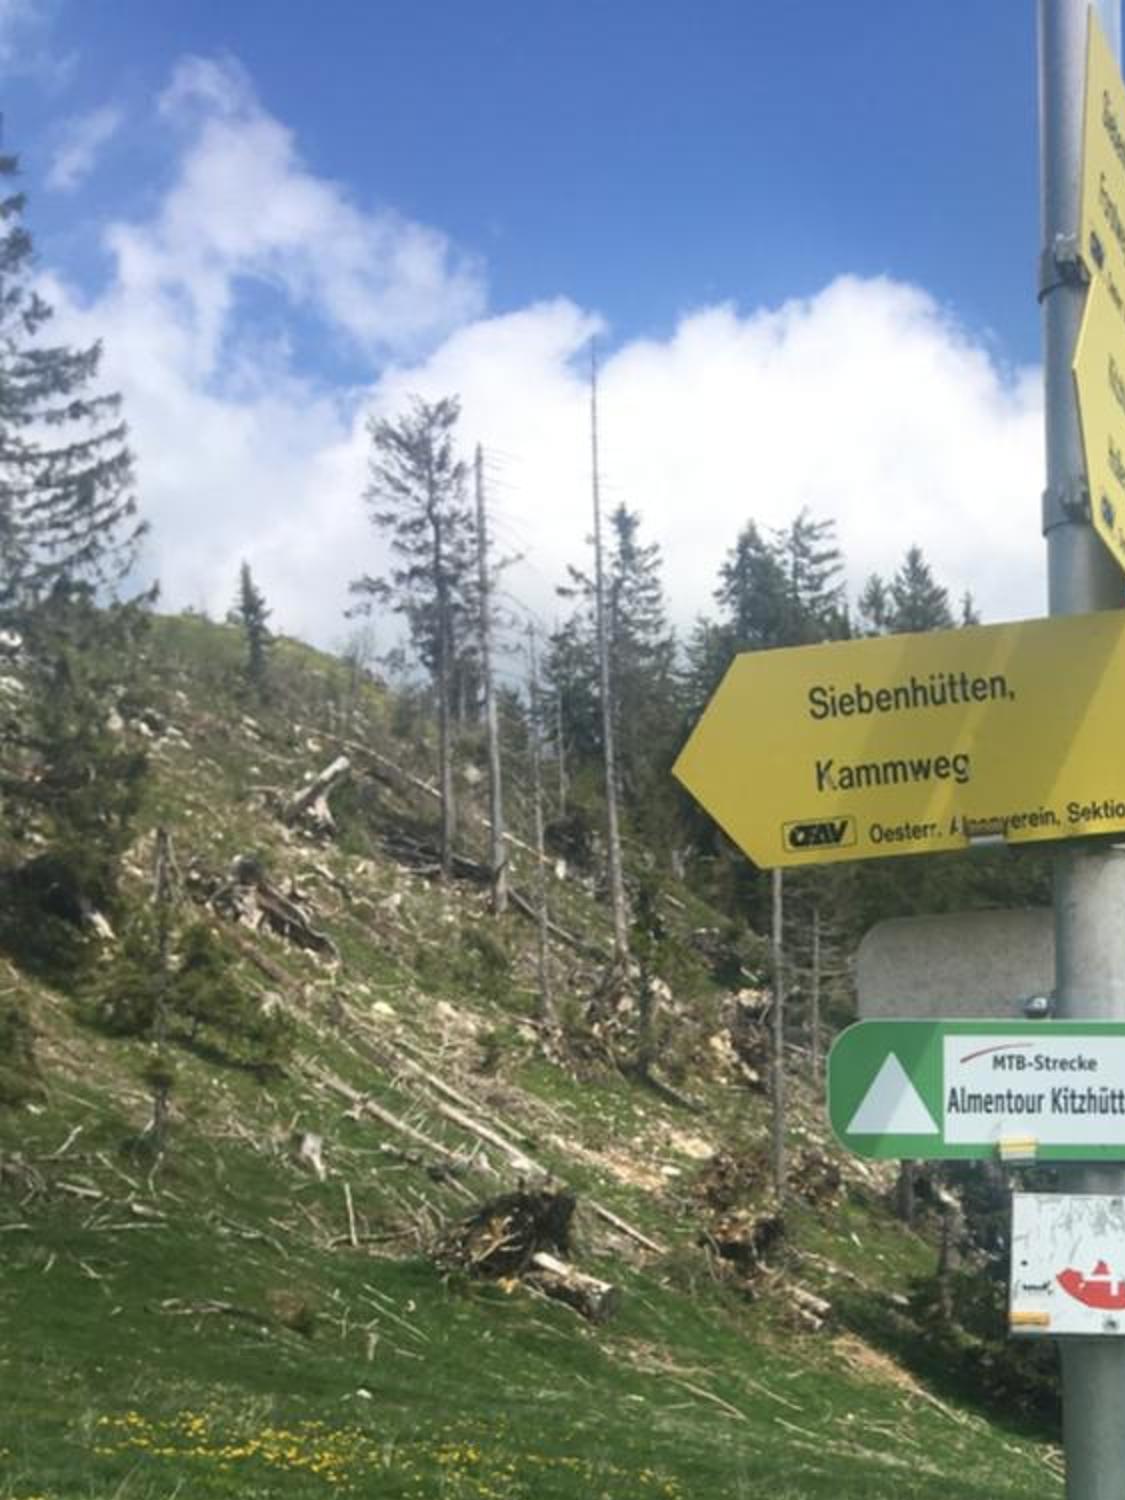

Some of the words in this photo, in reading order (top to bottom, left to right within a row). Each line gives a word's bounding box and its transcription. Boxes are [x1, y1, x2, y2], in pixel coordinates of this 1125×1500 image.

[808, 671, 1016, 720] Siebenhütten,
[815, 752, 970, 793] Kammweg
[869, 822, 942, 845] Oesterr.
[991, 1053, 1099, 1072] MTB-Strecke
[947, 1086, 1046, 1115] Almentour
